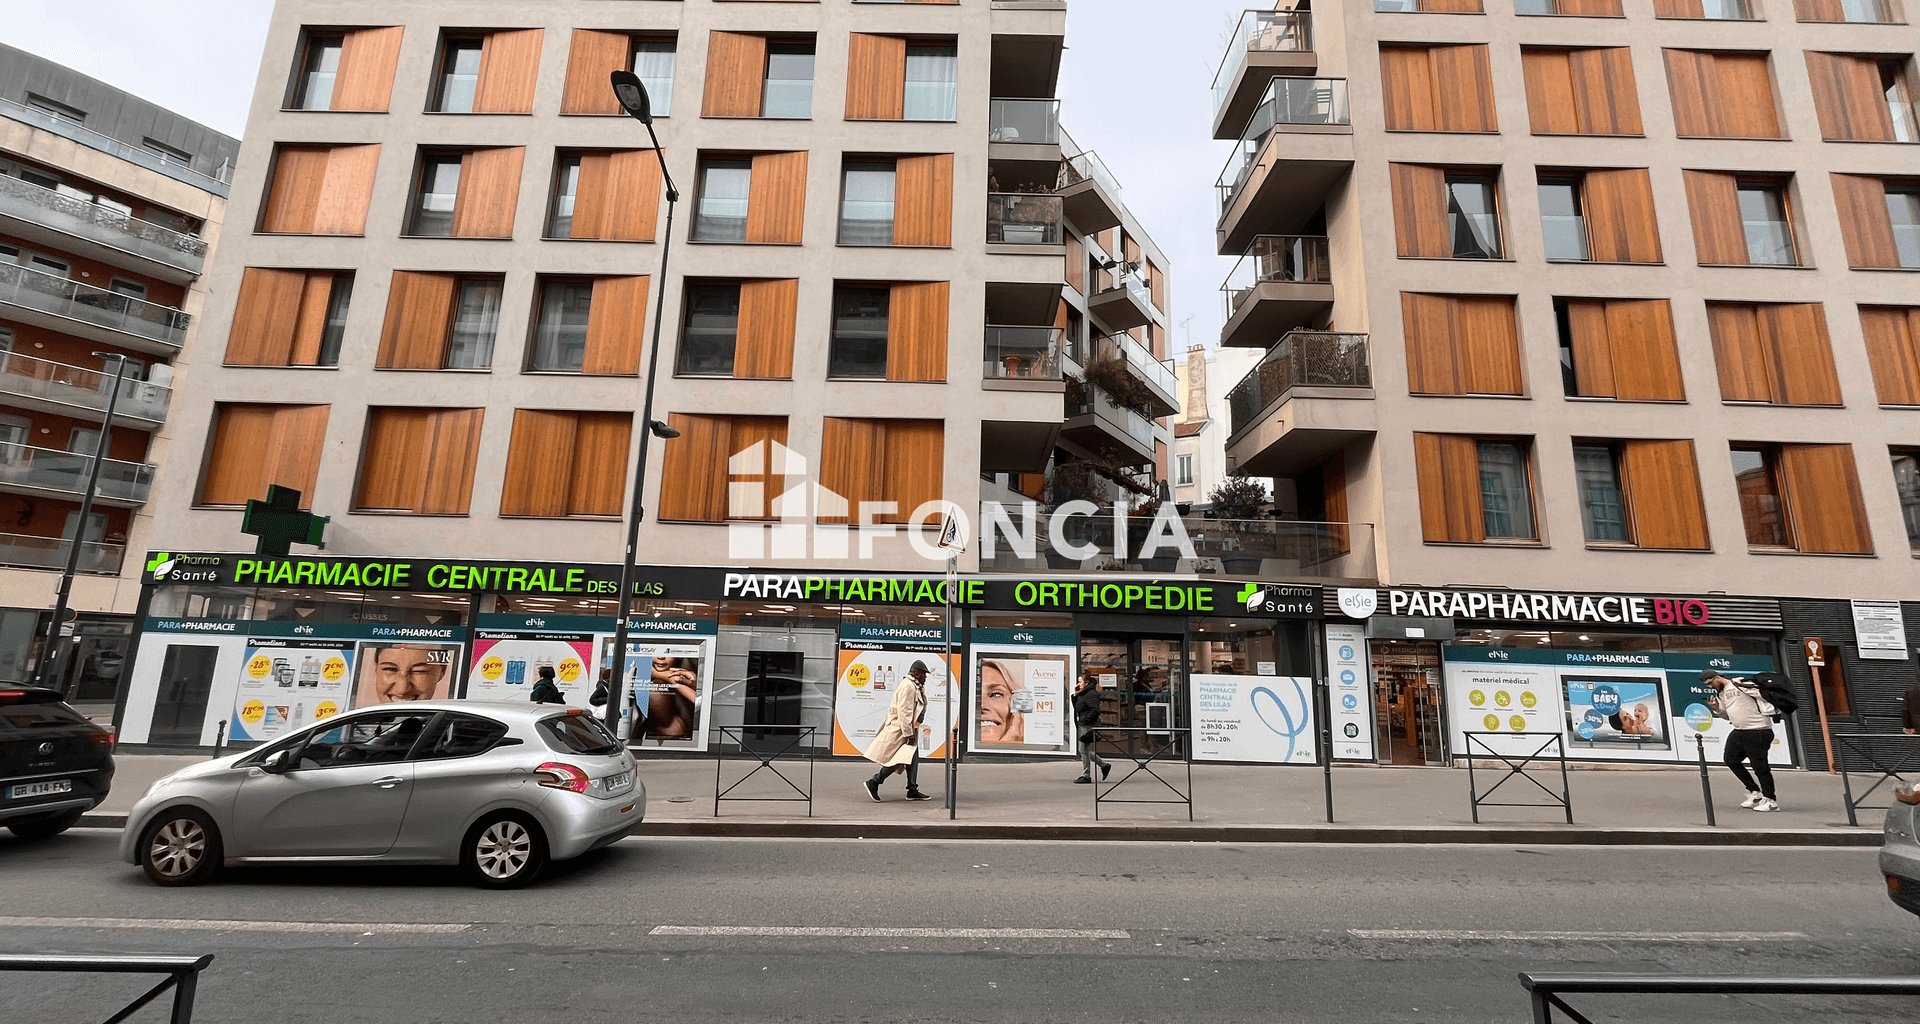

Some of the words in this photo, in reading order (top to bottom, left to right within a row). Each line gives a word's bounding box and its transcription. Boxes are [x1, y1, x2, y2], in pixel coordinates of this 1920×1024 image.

[174, 553, 220, 566] Pharma
[171, 570, 217, 582] Santé
[234, 560, 411, 588] PHARMACIE
[427, 564, 585, 592] CENTRALE
[587, 580, 618, 594] DES
[723, 573, 985, 605] PARAPHARMACIE
[1014, 579, 1214, 611] ORTHOPÉDIE
[1264, 584, 1313, 597] Pharma
[1265, 600, 1314, 613] Santé
[1389, 589, 1649, 624] PARAPHARMACIE
[1654, 598, 1710, 625] BIO
[157, 620, 236, 632] PARA+PHARMACIE
[628, 621, 697, 631] RA+PHARMACIE
[372, 627, 452, 638] PARA+PHARMACIE
[479, 631, 518, 640] Promotions
[860, 627, 942, 638] PARA+PHARMACIE
[844, 641, 884, 650] Promotions
[427, 651, 451, 663] SVR
[1566, 653, 1650, 664] PARA+PHARMACIE
[1593, 693, 1618, 704] BABY
